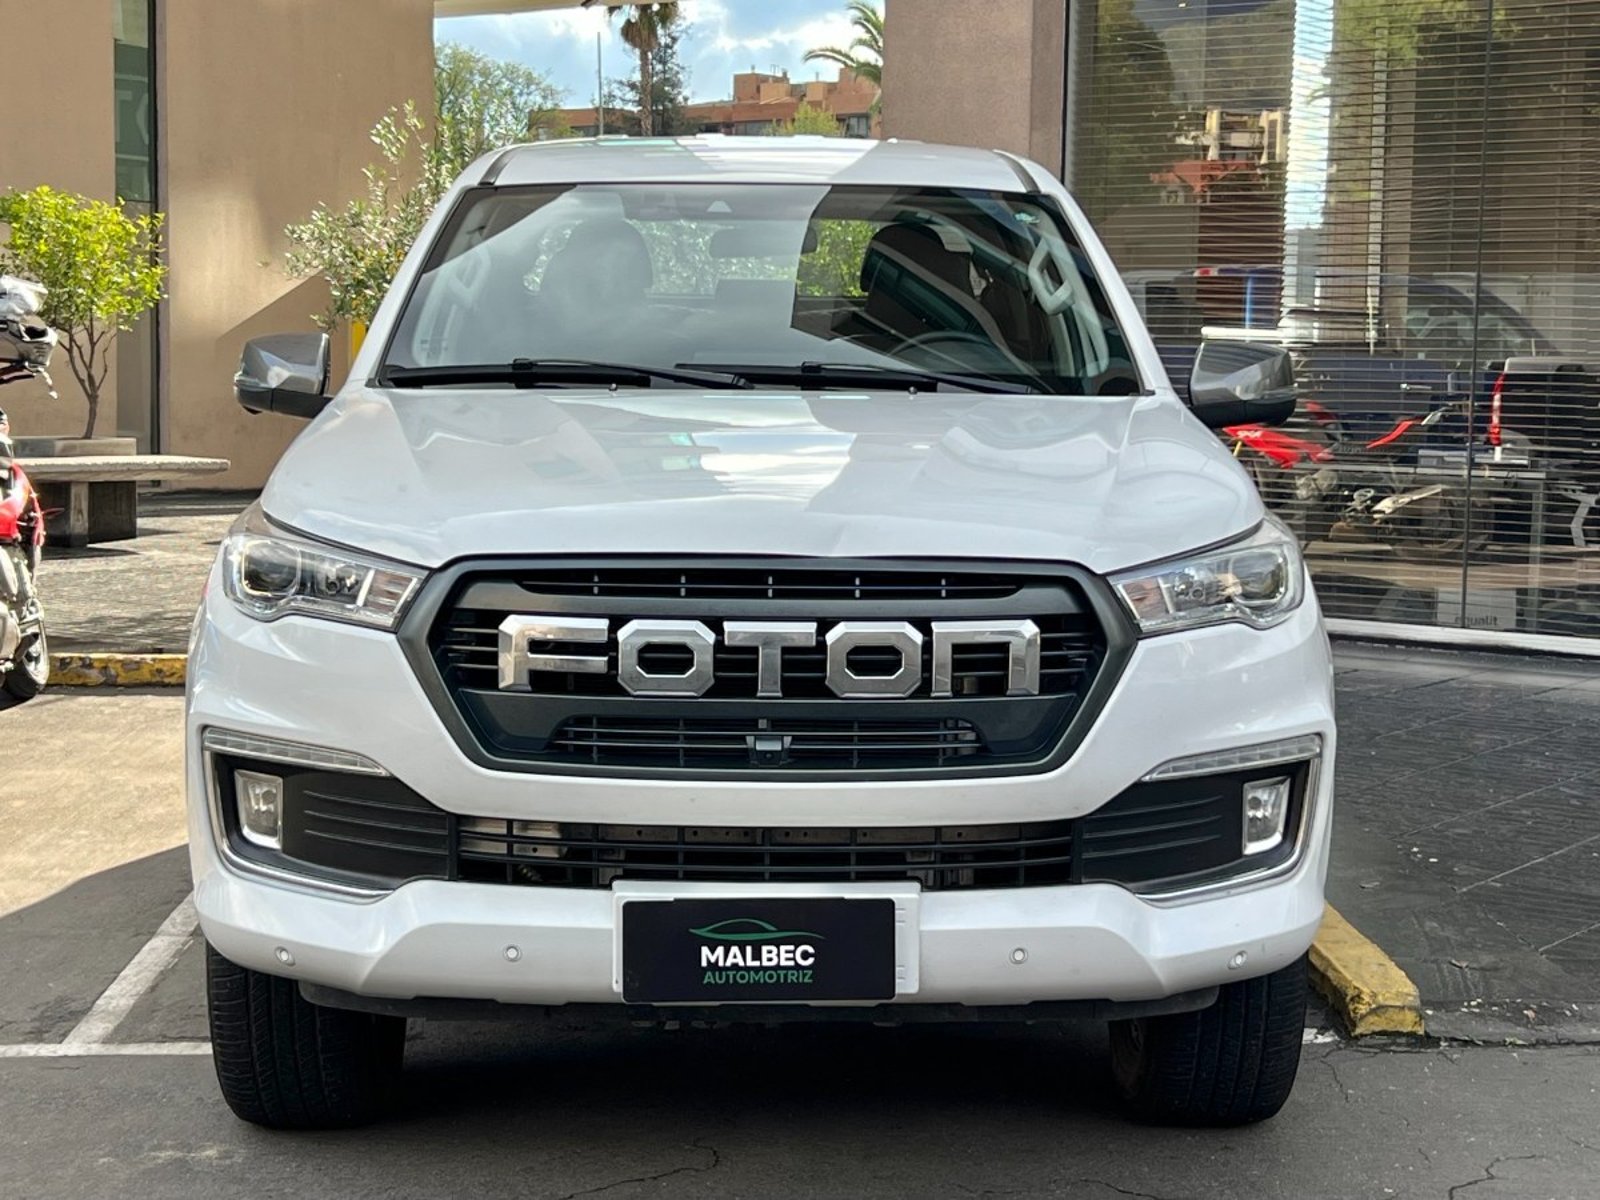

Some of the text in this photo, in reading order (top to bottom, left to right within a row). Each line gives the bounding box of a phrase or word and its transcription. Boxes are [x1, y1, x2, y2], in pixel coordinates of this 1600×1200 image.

[498, 614, 1041, 699] FOTON
[700, 944, 816, 968] MALBEC
[702, 969, 814, 985] AUTOMOTRIZ
